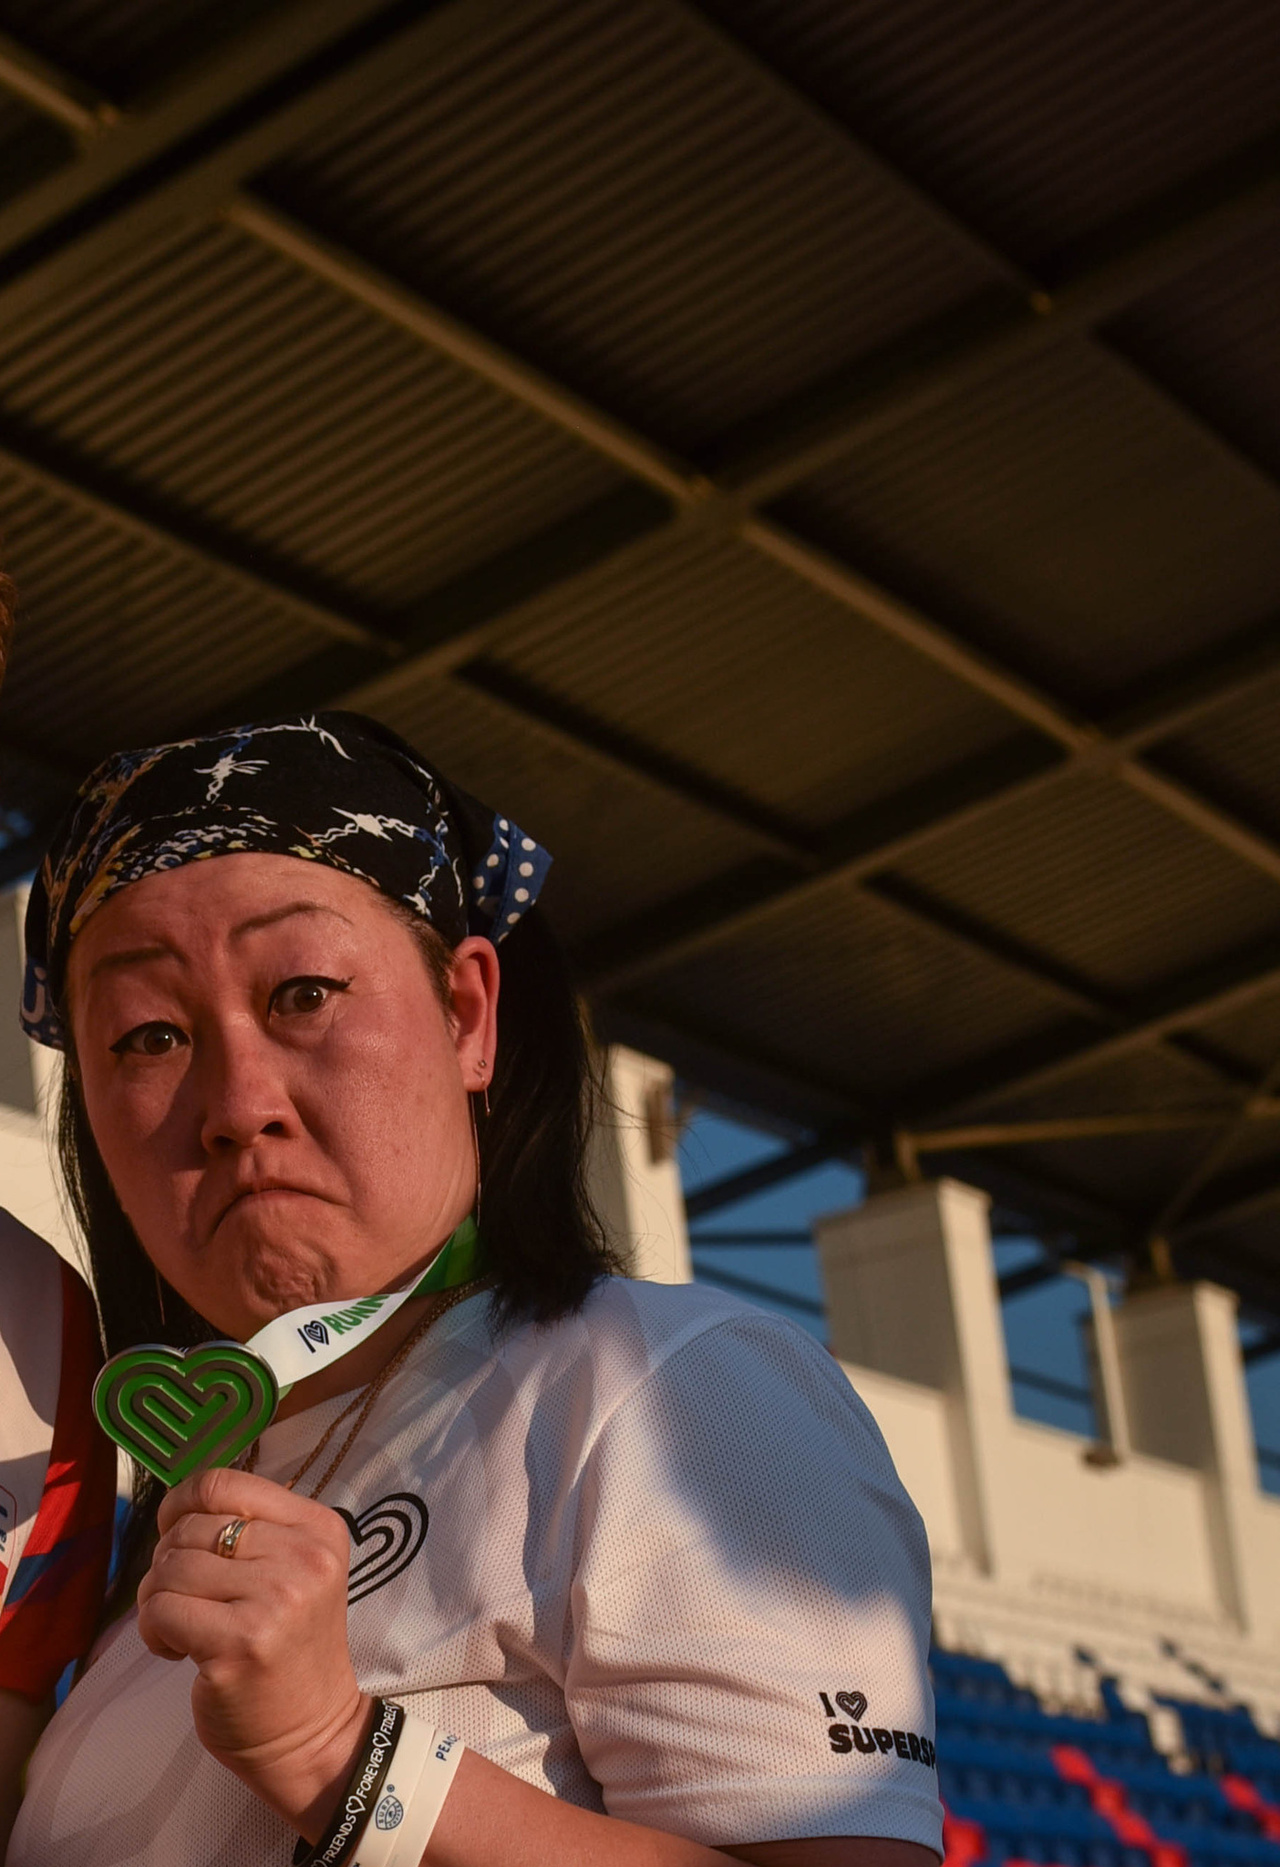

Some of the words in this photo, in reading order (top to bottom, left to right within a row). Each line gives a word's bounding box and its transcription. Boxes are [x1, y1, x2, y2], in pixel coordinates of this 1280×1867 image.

[819, 1692, 836, 1718] I
[322, 1813, 357, 1864] FRIENDS
[356, 1747, 385, 1799] FOREVER
